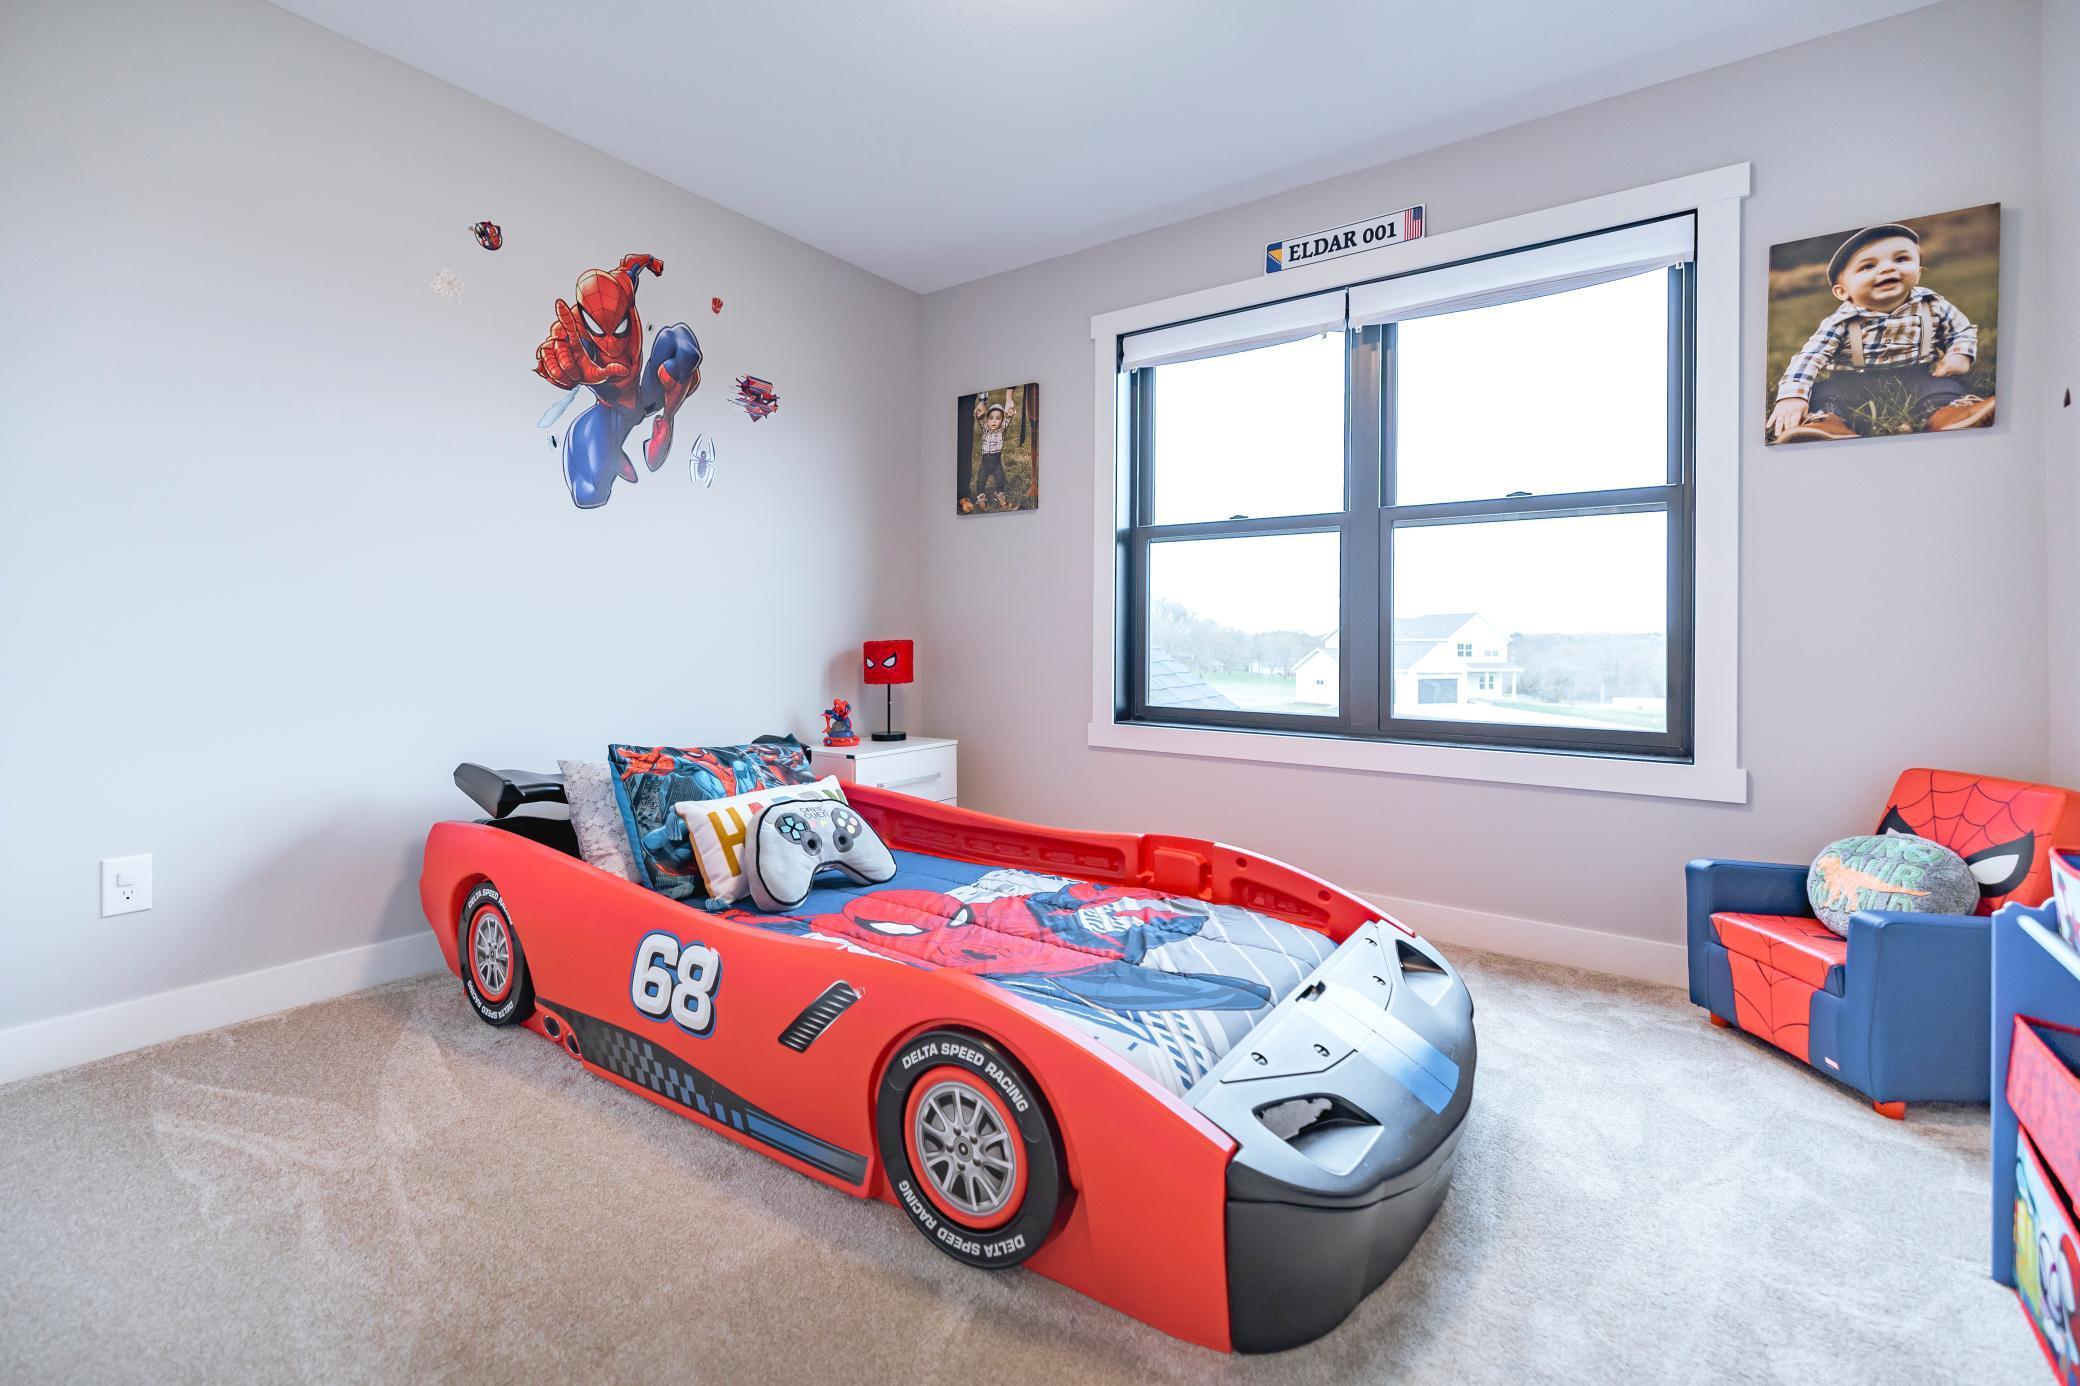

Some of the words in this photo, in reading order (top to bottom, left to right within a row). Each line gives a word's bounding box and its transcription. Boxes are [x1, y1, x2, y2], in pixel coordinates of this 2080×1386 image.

[1288, 230, 1358, 262] ELDAR
[1362, 221, 1397, 244] 001
[468, 889, 482, 909] DELTA
[482, 888, 499, 901] SPEED
[467, 979, 483, 1009] RACING
[630, 930, 722, 1038] 68
[481, 1005, 498, 1020] SPEED
[497, 1000, 514, 1019] DELTA
[901, 1043, 939, 1070] DELTA
[940, 1042, 985, 1067] SPEED
[984, 1061, 1029, 1113] RACING
[898, 1180, 938, 1231] RACING
[937, 1228, 981, 1256] SPEED
[983, 1234, 1026, 1258] DELTA
